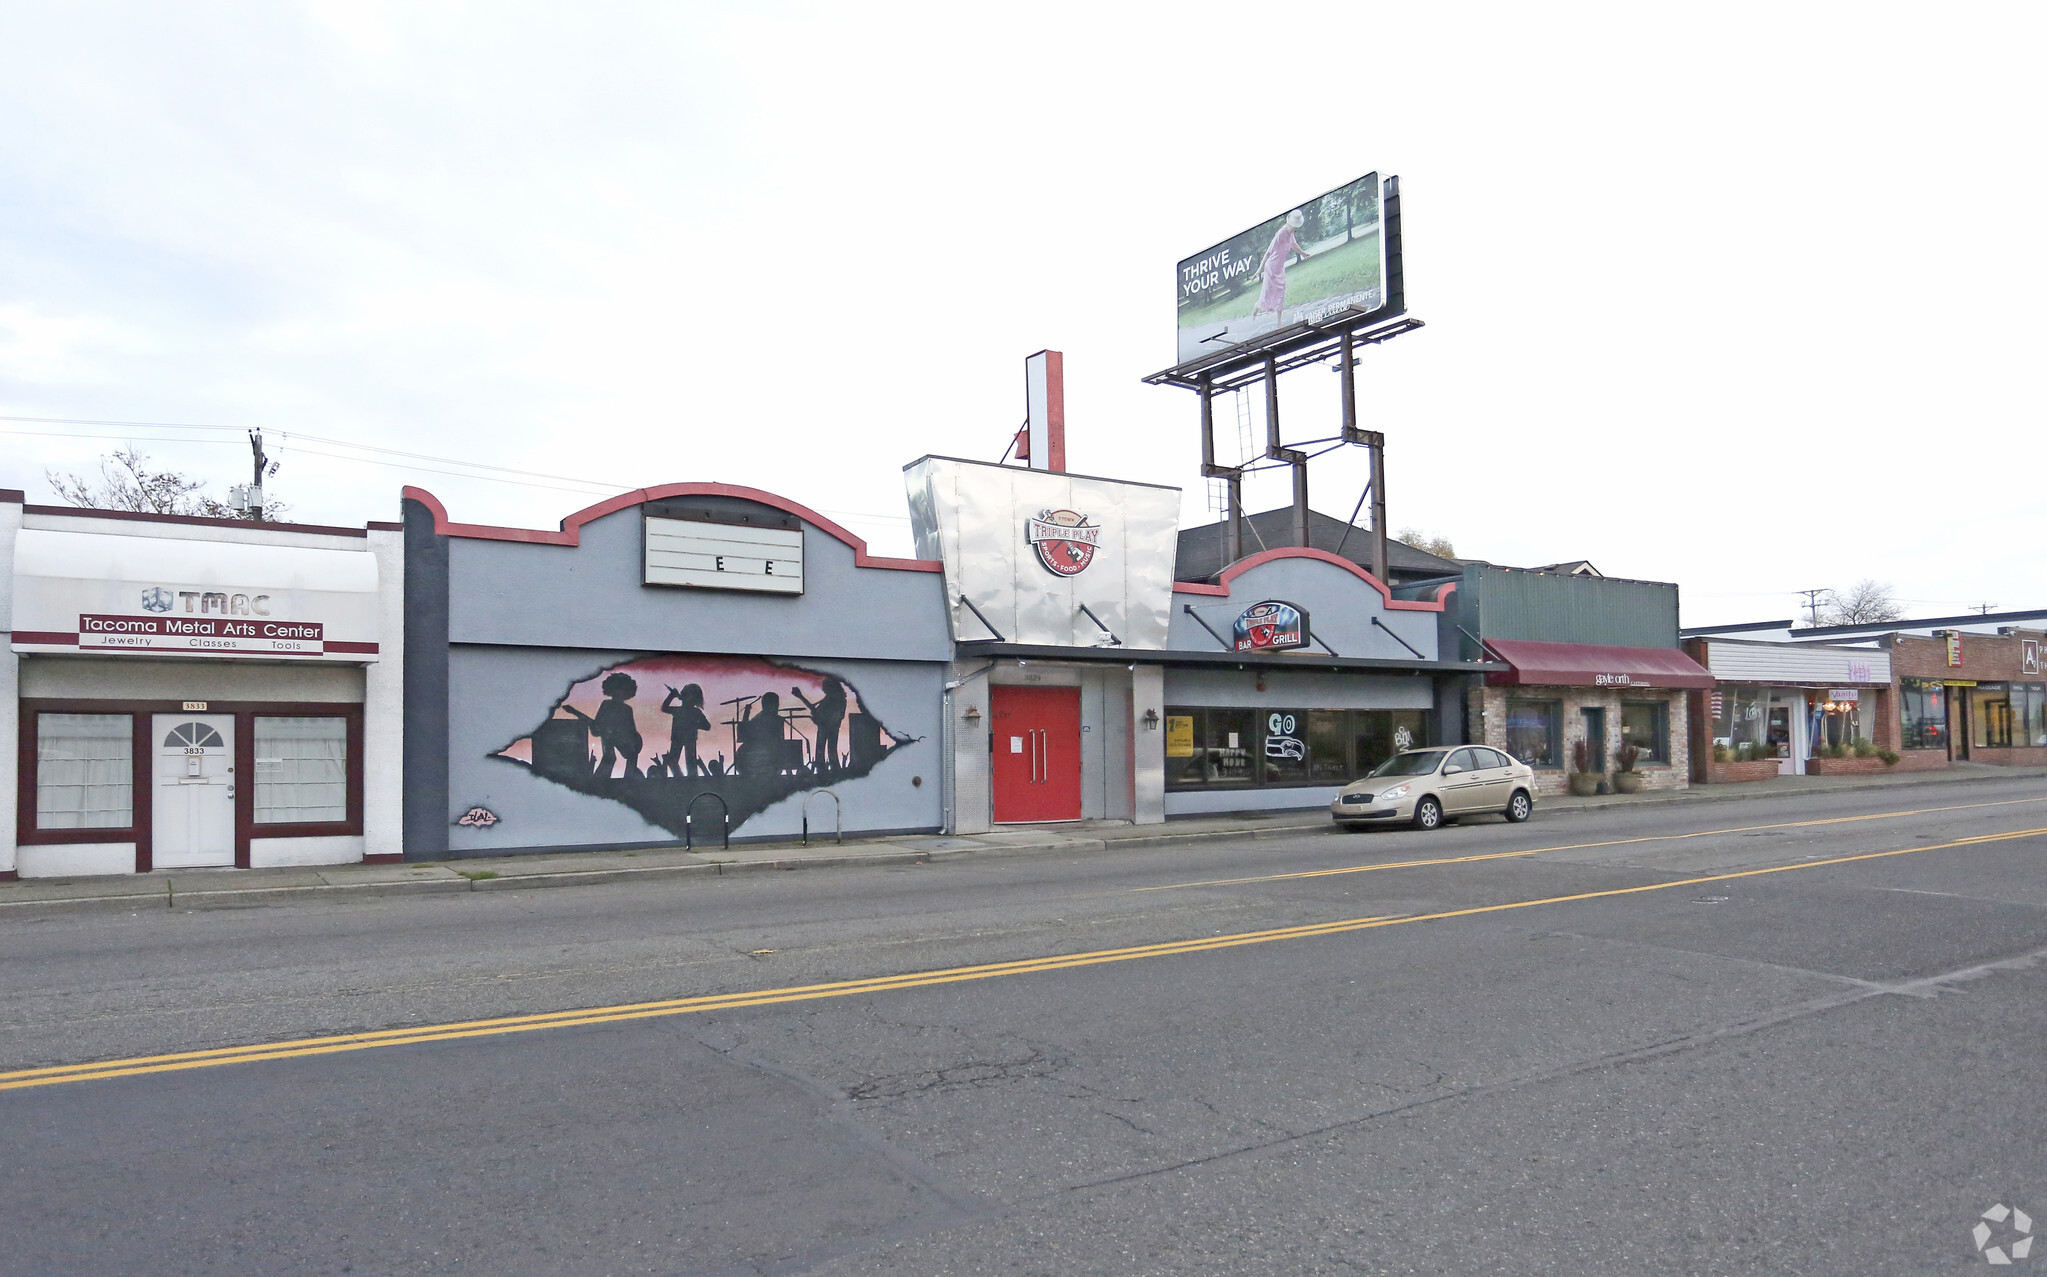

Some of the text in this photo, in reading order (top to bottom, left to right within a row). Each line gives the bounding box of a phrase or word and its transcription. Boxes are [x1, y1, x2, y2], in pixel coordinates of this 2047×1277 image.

[1183, 249, 1230, 281] THRIVE
[1183, 255, 1253, 297] YOUR WAY
[1328, 290, 1373, 312] PERMANENTE
[1035, 524, 1098, 543] TRIPLE PLAY
[1042, 541, 1058, 567] SPORTS
[1080, 546, 1092, 567] MUSIC
[716, 556, 773, 575] E E
[179, 591, 270, 616] TMAC
[83, 617, 320, 638] Tacoma Metal Arts Center
[101, 636, 301, 650] Jewelry Classes Tools
[1238, 640, 1252, 651] BAR
[1272, 633, 1298, 645] GRILL
[1268, 713, 1296, 736] GO
[183, 747, 205, 755] 3833
